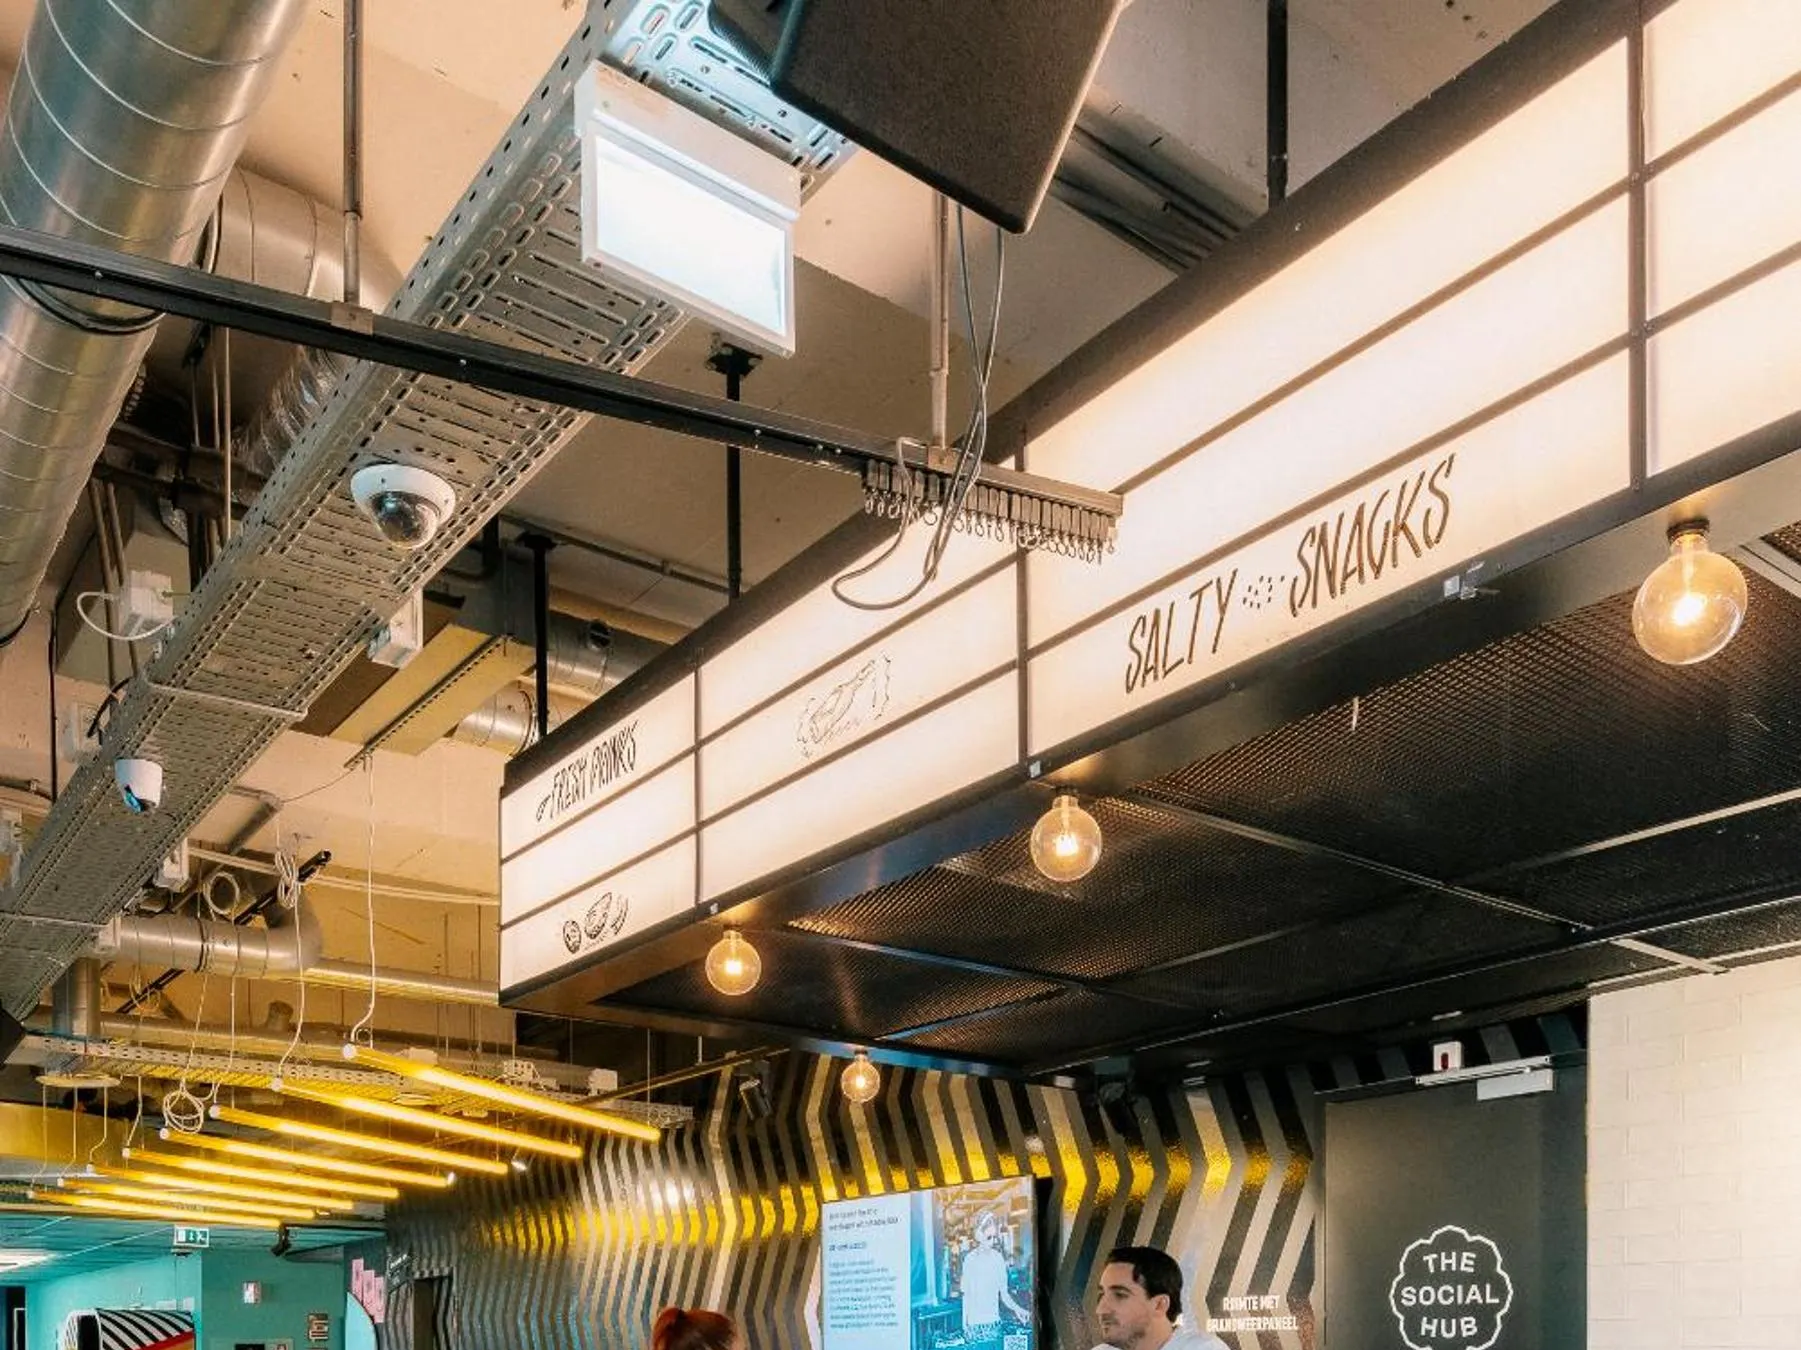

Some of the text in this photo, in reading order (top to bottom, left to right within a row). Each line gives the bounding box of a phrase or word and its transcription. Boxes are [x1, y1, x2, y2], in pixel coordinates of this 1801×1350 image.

[1125, 452, 1456, 694] SALTY SNACKS
[1422, 1251, 1477, 1274] THE
[1400, 1283, 1501, 1307] SOCIAL
[1420, 1316, 1478, 1339] HUB
